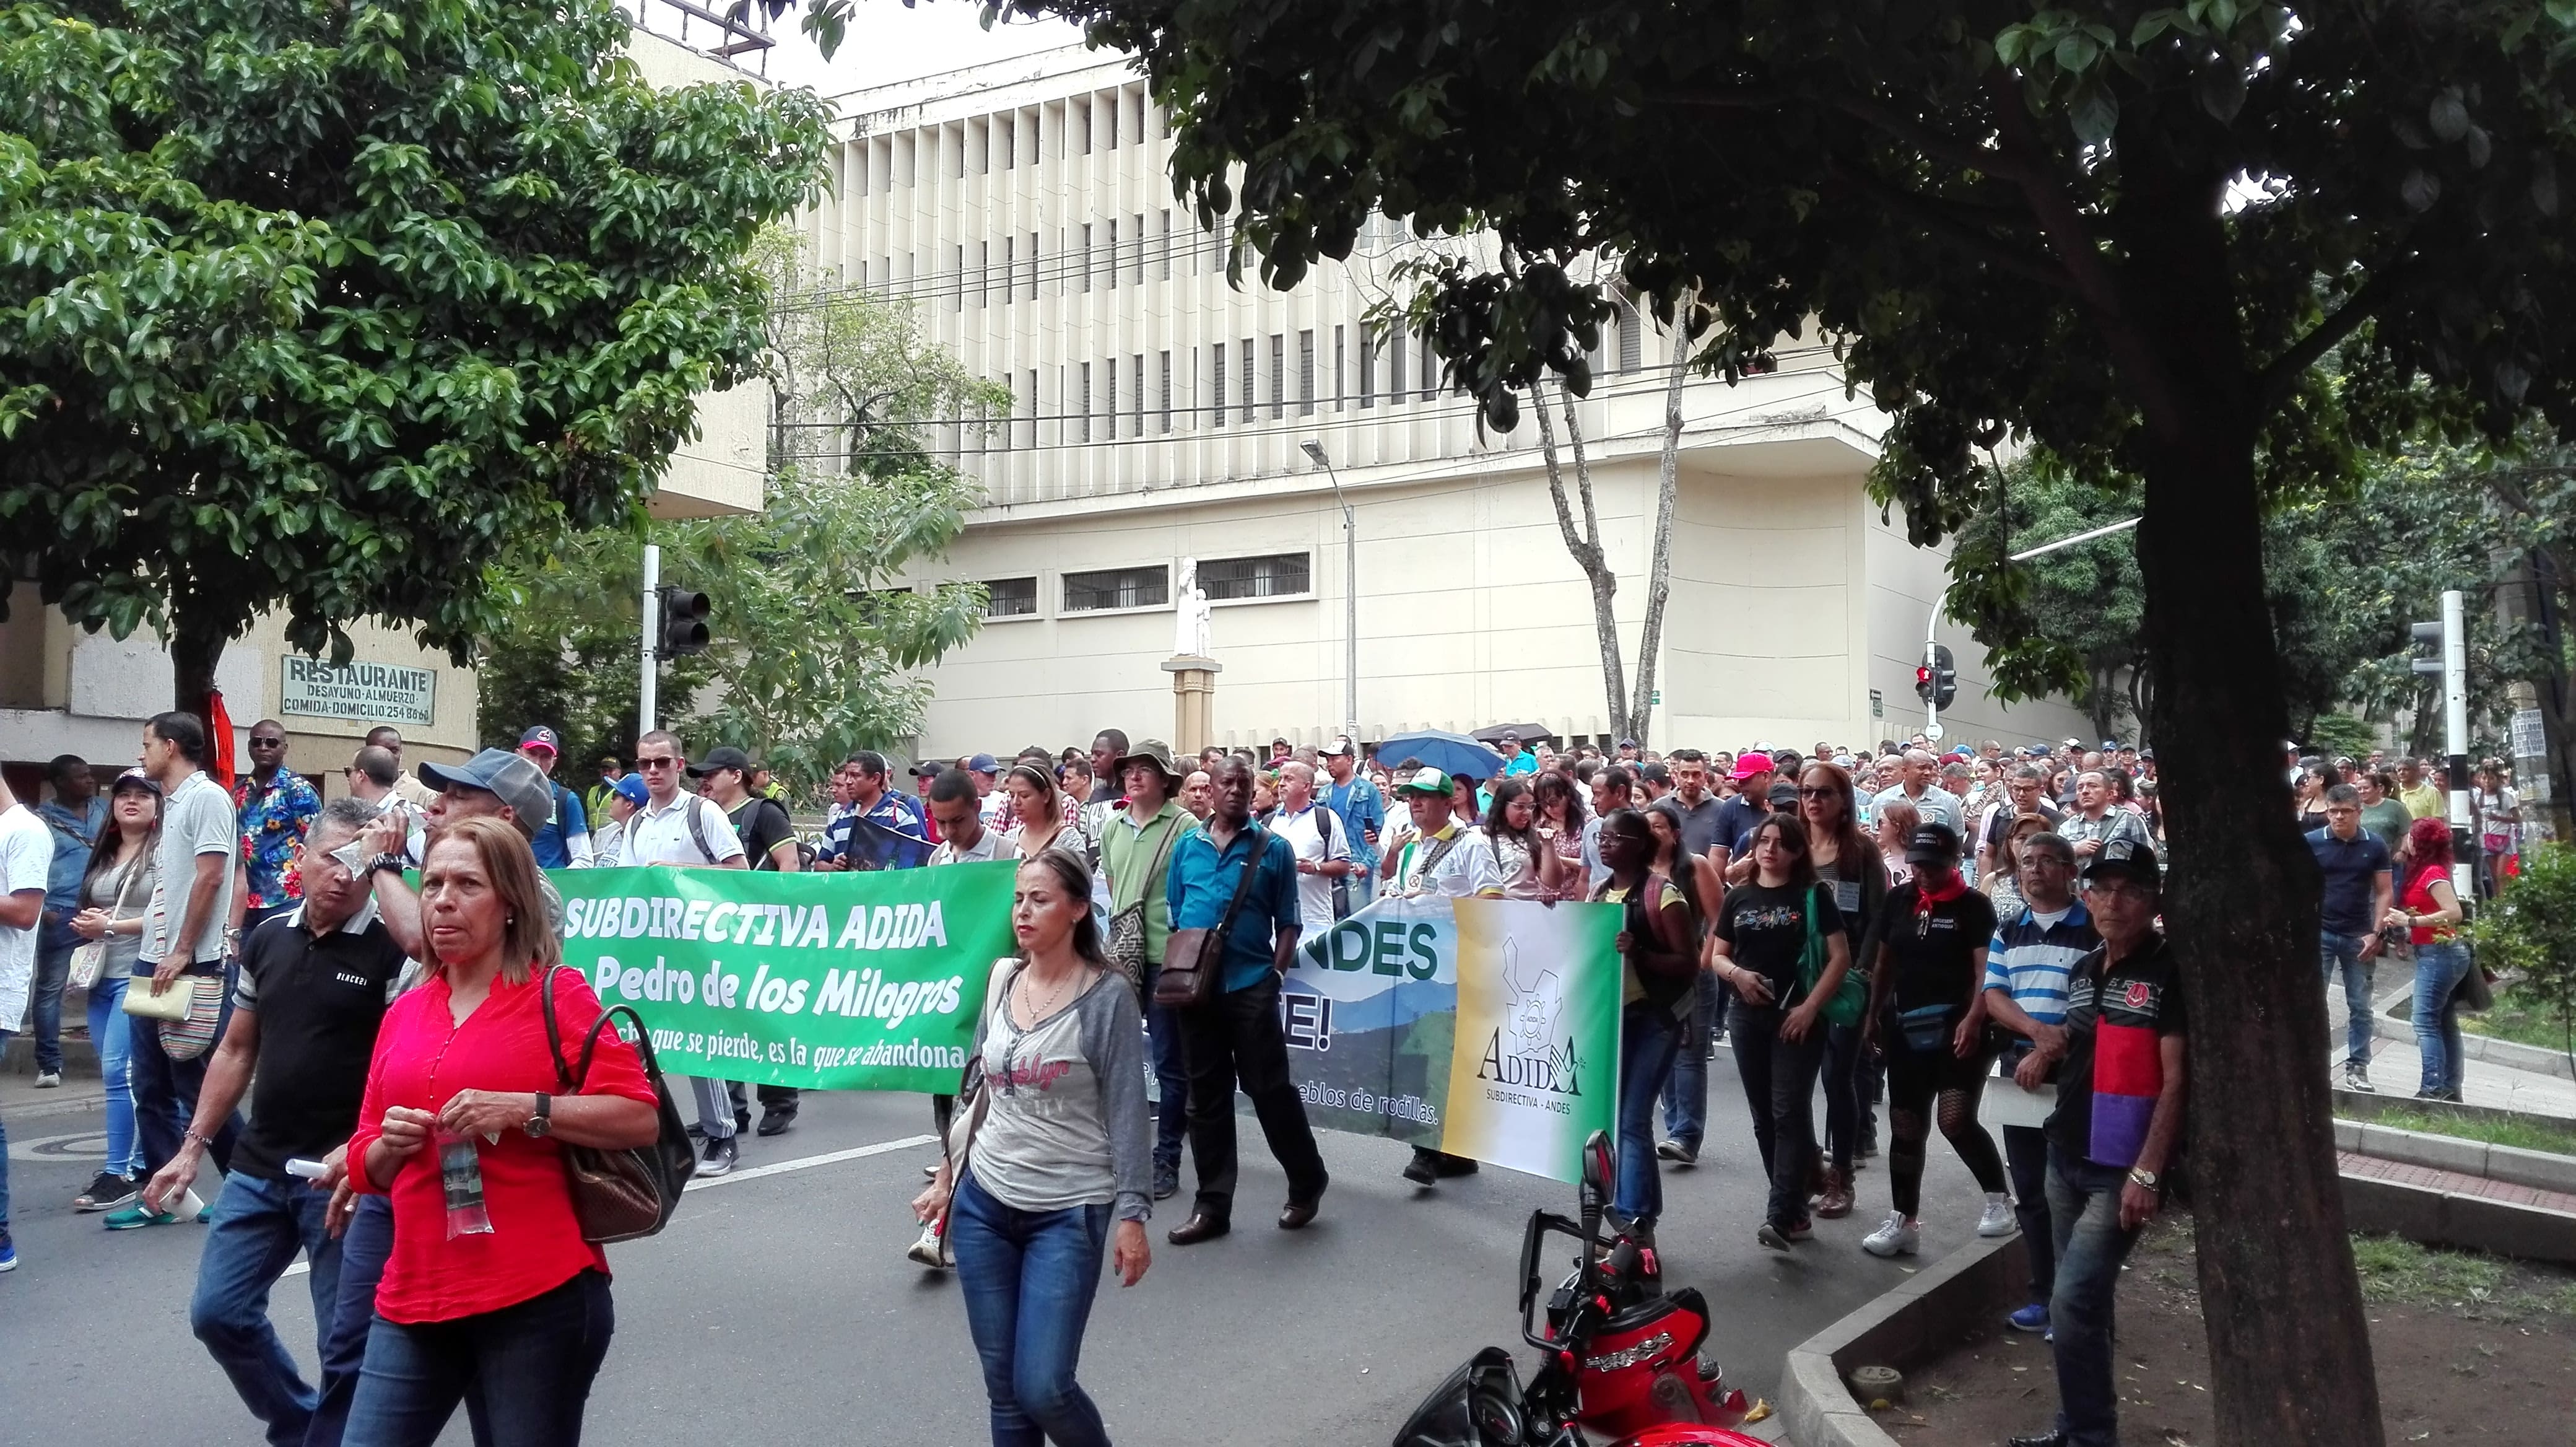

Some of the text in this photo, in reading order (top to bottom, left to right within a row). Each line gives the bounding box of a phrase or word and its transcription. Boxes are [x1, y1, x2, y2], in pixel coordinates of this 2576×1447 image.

[290, 658, 427, 693] RESTAURANTE
[564, 897, 947, 950] SUBDIRECTIVA ADIDA
[1289, 919, 1438, 981] NDES
[594, 956, 964, 1030] Pedro de los Milagros
[652, 1028, 684, 1055] que
[686, 1032, 703, 1054] se
[707, 1029, 764, 1064] pierde,
[768, 1041, 785, 1064] es
[790, 1037, 807, 1066] la
[813, 1045, 846, 1073] que
[843, 1046, 863, 1067] se
[861, 1038, 966, 1069] abandona
[1298, 1080, 1438, 1126] eblos de rodillas.
[1486, 1088, 1538, 1109] SUBDIRECTIVA
[1545, 1099, 1571, 1115] ANDES
